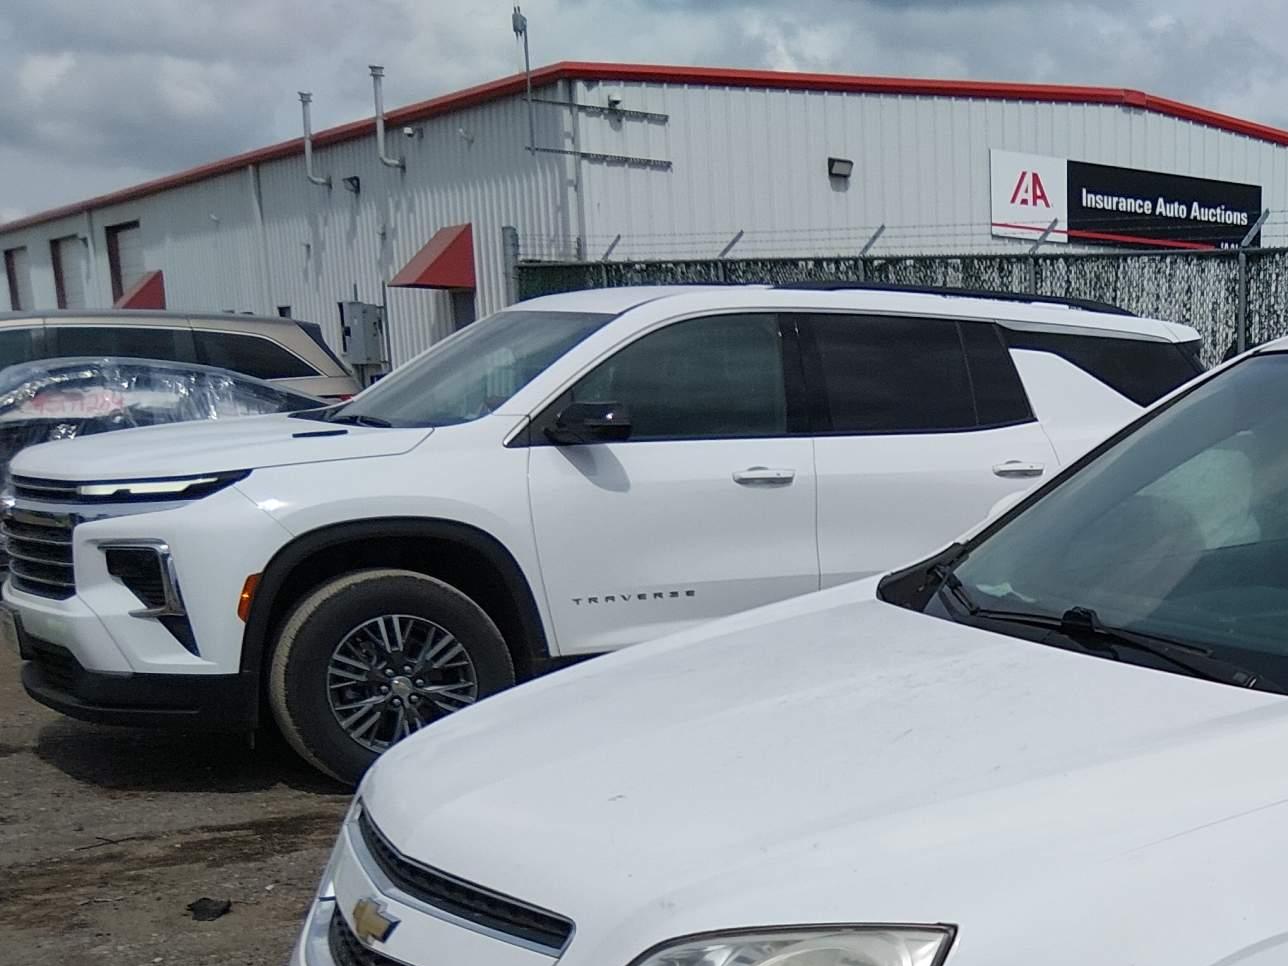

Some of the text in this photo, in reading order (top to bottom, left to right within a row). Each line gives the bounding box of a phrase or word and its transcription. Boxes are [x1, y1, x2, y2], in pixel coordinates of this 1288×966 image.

[1081, 187, 1248, 226] Insurance Auto Auctions
[571, 589, 696, 606] TRAVERSE
